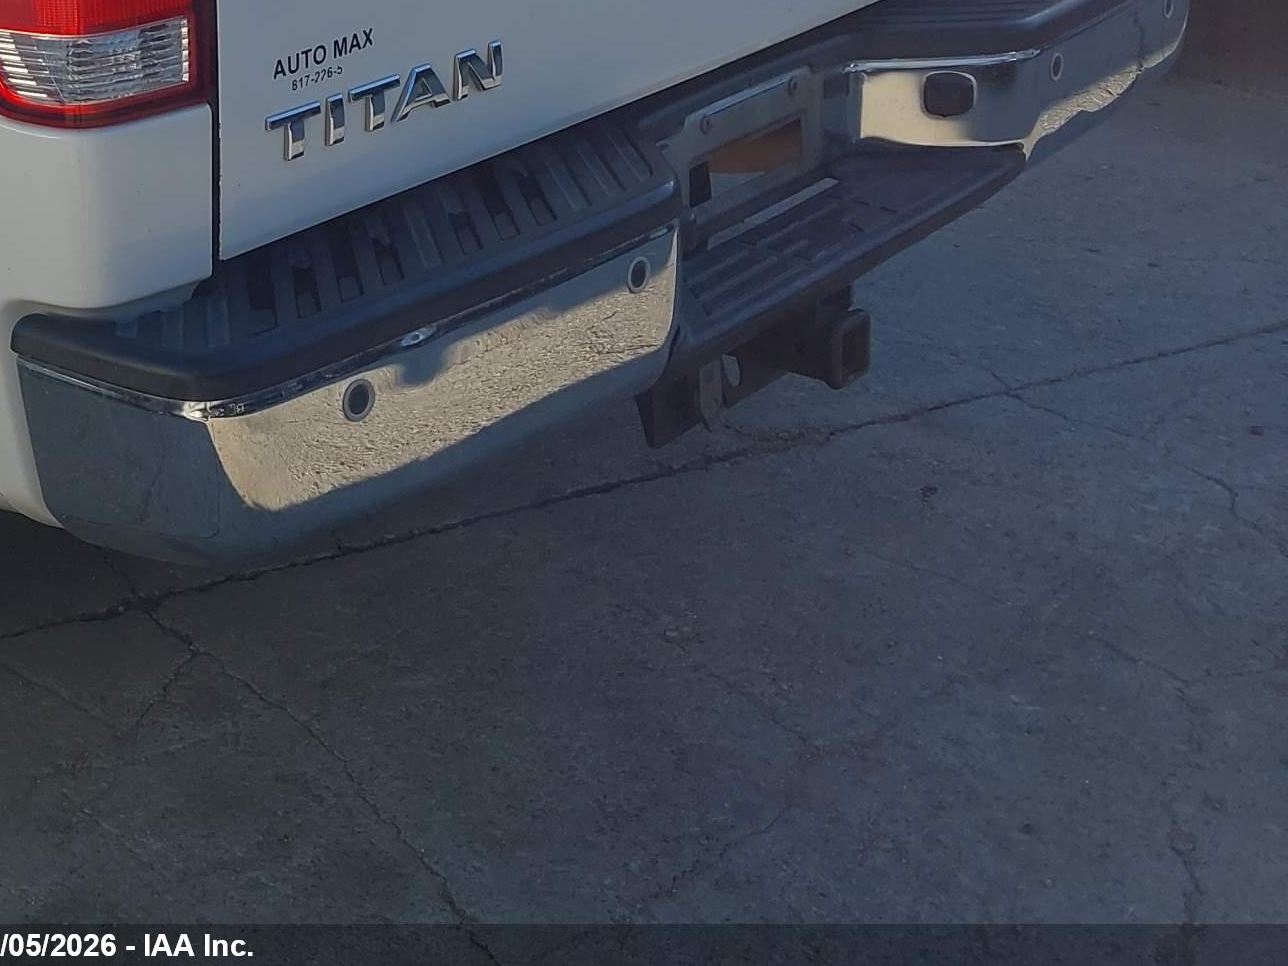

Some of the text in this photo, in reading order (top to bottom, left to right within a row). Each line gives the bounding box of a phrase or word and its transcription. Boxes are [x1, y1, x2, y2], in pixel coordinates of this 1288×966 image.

[273, 27, 373, 80] AUTO MAX
[265, 40, 502, 161] TITAN
